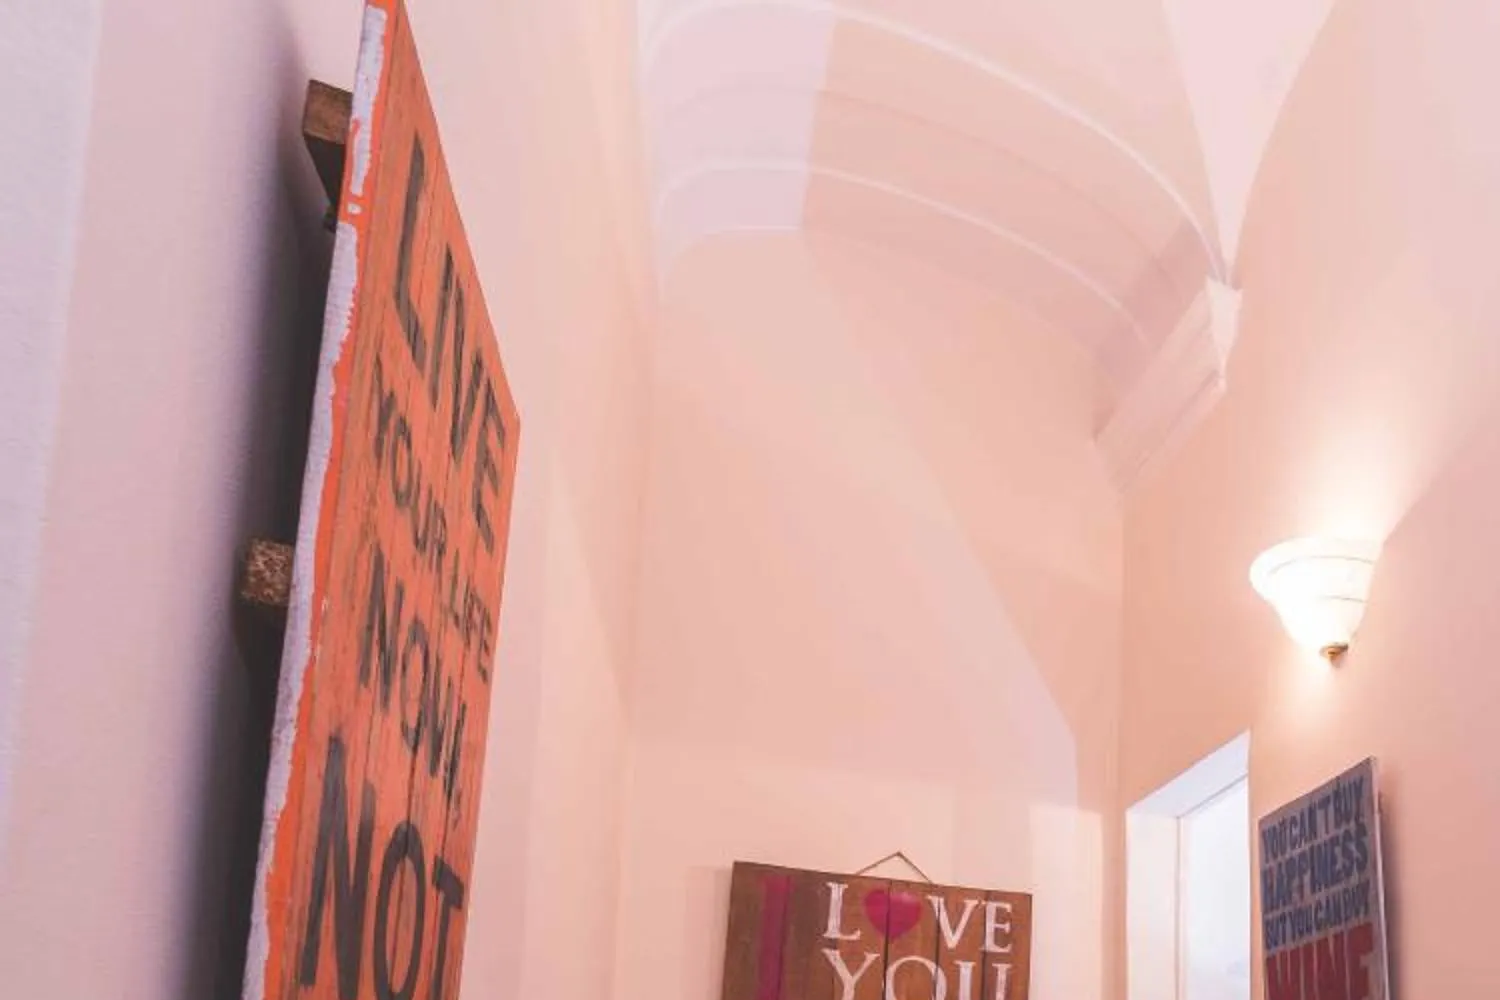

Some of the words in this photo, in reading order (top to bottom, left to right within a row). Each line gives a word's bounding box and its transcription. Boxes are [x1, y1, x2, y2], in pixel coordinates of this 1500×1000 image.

[394, 128, 505, 557] LIVE
[373, 351, 447, 573] YOUR
[449, 548, 492, 682] LIFE
[1262, 816, 1287, 863] YOU
[1333, 776, 1364, 829] BUY
[1262, 821, 1368, 912] HAPPINESS
